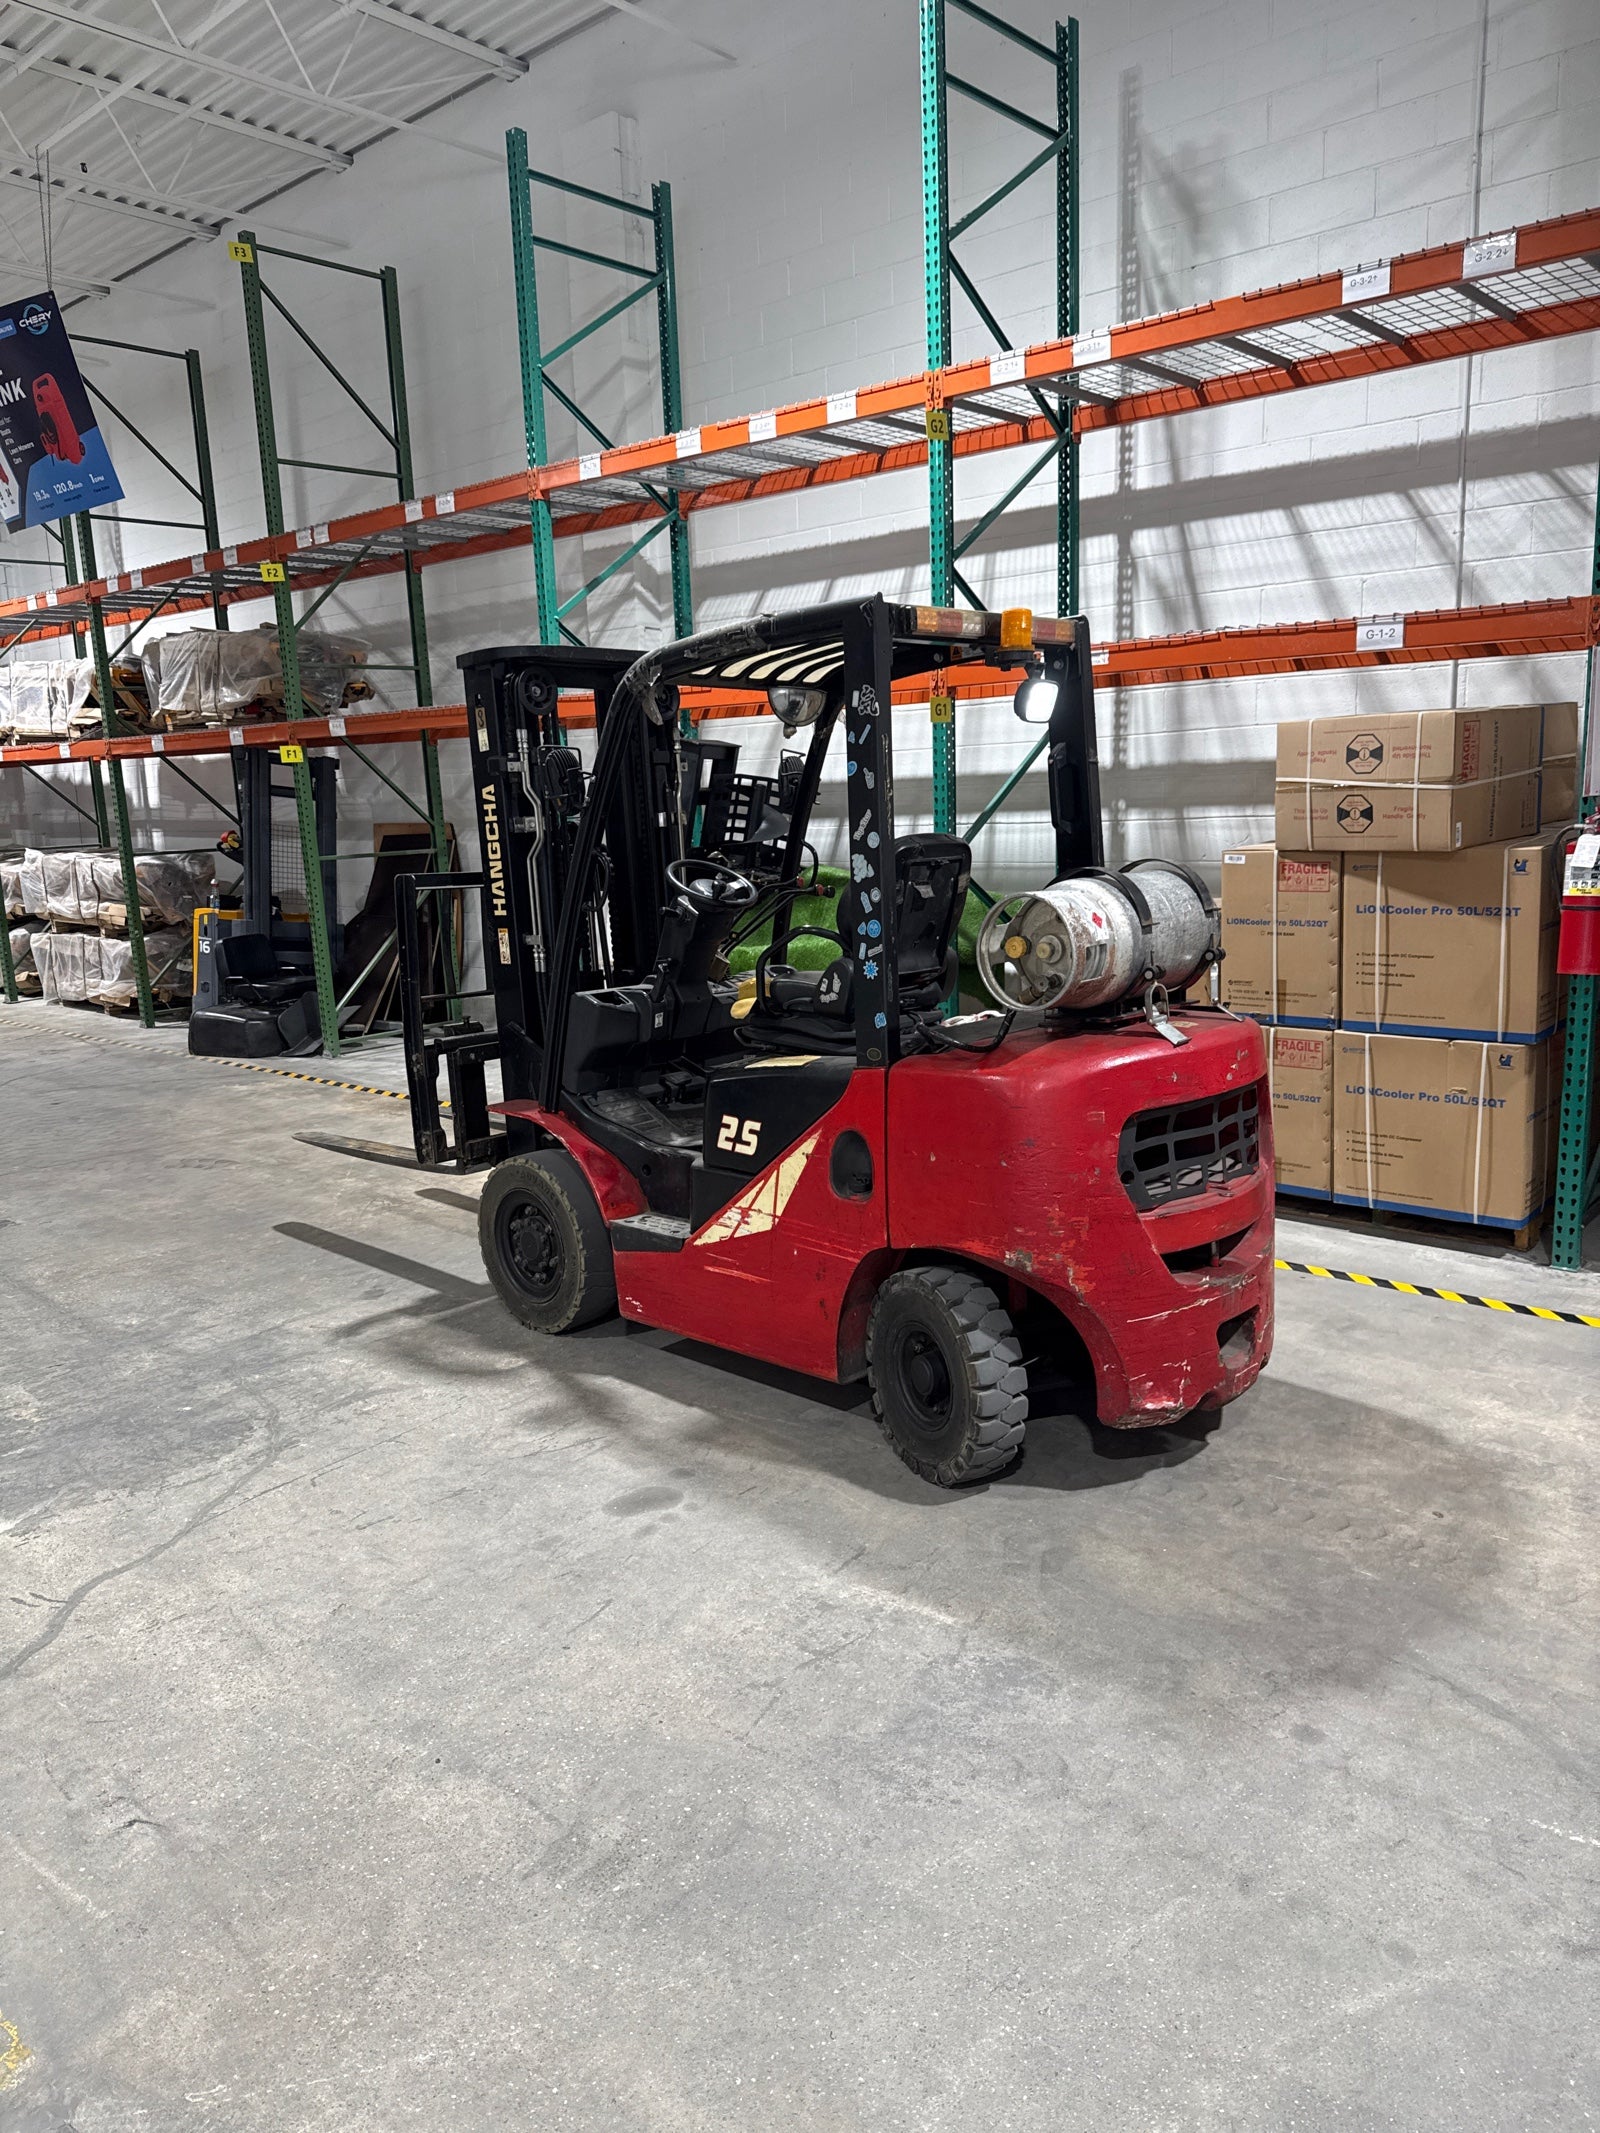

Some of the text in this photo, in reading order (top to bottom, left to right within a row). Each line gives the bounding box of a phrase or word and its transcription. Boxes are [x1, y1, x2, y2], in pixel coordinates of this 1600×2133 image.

[233, 247, 247, 258] F3
[19, 311, 52, 327] CHERY
[930, 419, 944, 434] G2
[267, 568, 279, 578] F2
[1366, 628, 1396, 640] G-1-2
[935, 703, 947, 717] G1
[286, 750, 298, 759] F1
[481, 783, 508, 916] HANGCHA
[1281, 863, 1328, 875] FRAGILE
[1431, 906, 1453, 916] Pro
[1226, 918, 1271, 926] LiONCooler
[1289, 919, 1328, 928] 50L/52QT
[198, 940, 211, 953] 16
[1276, 1040, 1321, 1053] FRAGILE
[1283, 1092, 1321, 1103] 50L/52QT
[1419, 1092, 1440, 1103] Pro
[716, 1114, 762, 1156] 25
